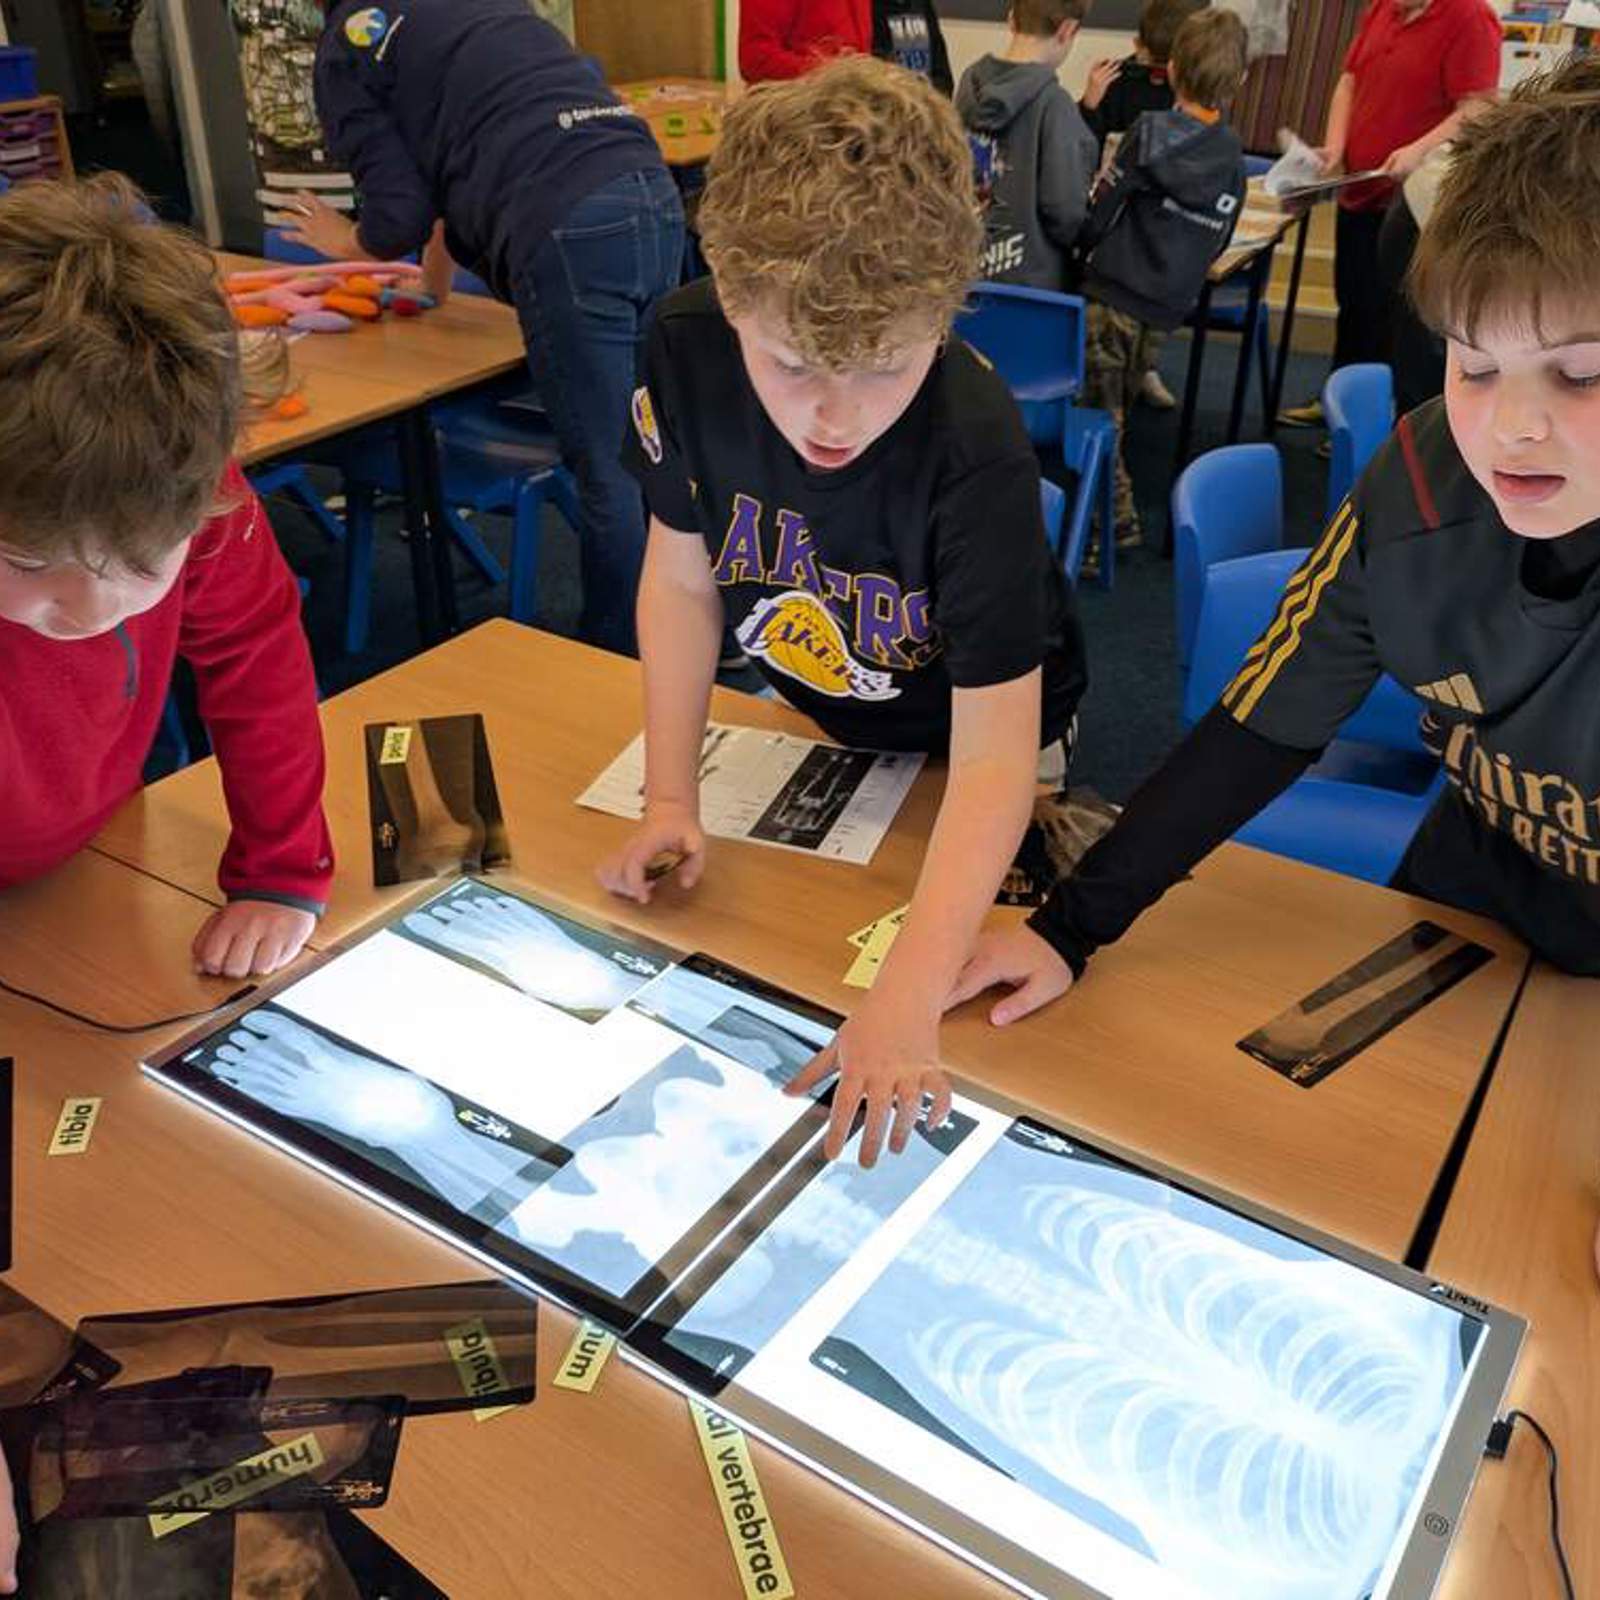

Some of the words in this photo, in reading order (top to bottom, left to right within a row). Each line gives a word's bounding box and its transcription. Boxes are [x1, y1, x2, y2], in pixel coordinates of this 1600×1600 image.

[58, 1104, 93, 1146] tibia
[459, 1331, 500, 1396] ibula
[717, 1446, 779, 1594] vertebrae
